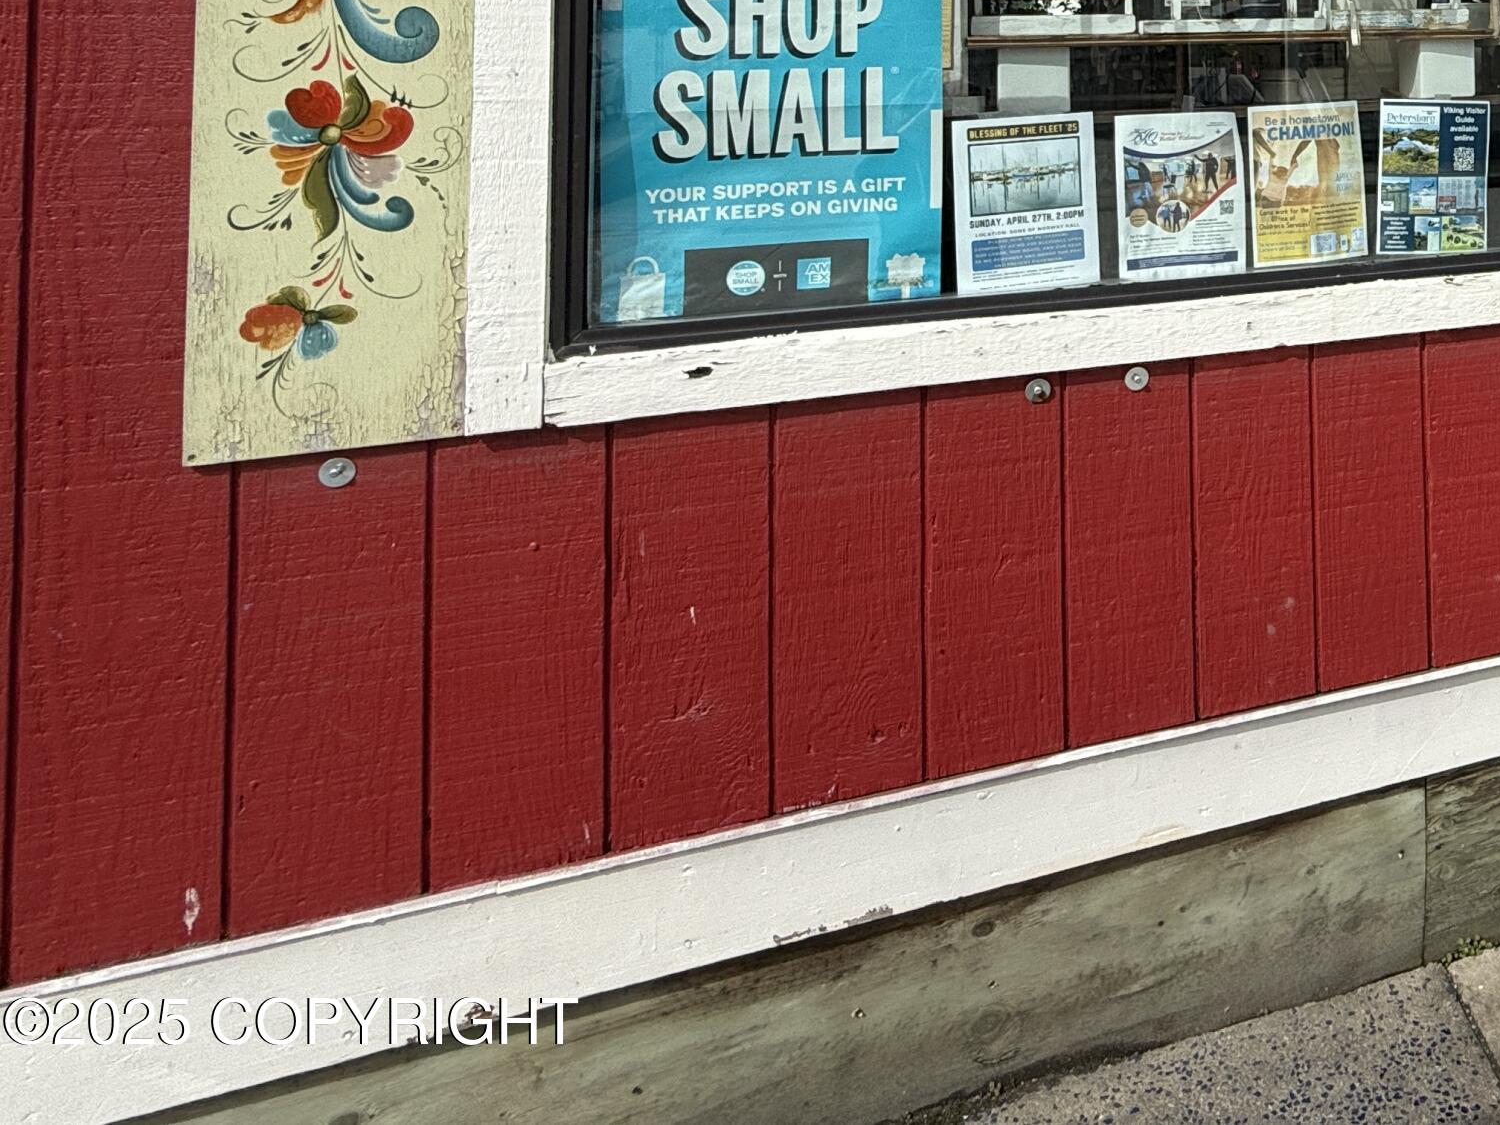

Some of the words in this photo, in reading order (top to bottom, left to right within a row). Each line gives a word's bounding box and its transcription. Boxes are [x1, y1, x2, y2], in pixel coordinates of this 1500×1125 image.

[652, 66, 900, 164] SMALL
[1443, 106, 1464, 116] Viking
[1465, 107, 1487, 115] Visitor
[1264, 116, 1278, 126] Be
[1288, 114, 1341, 125] hometown
[1455, 115, 1475, 124] Guide
[969, 130, 1008, 140] BLESSING
[1009, 128, 1021, 137] OF
[1022, 126, 1038, 135] THE
[1039, 124, 1063, 134] FLEET
[1267, 122, 1355, 141] CHAMPION!
[1454, 134, 1475, 142] online
[645, 186, 706, 205] YOUR
[711, 180, 812, 202] SUPPORT
[817, 179, 838, 195] IS
[842, 179, 857, 194] A
[861, 177, 906, 194] GIFT
[653, 206, 710, 225] THAT
[715, 202, 785, 221] KEEPS
[790, 199, 822, 217] ON
[827, 196, 899, 214] GIVING
[1006, 214, 1030, 225] APRIL
[1056, 209, 1085, 220] 2:00PM
[806, 262, 830, 275] AM
[732, 277, 760, 286] SMALL
[808, 273, 830, 285] EX
